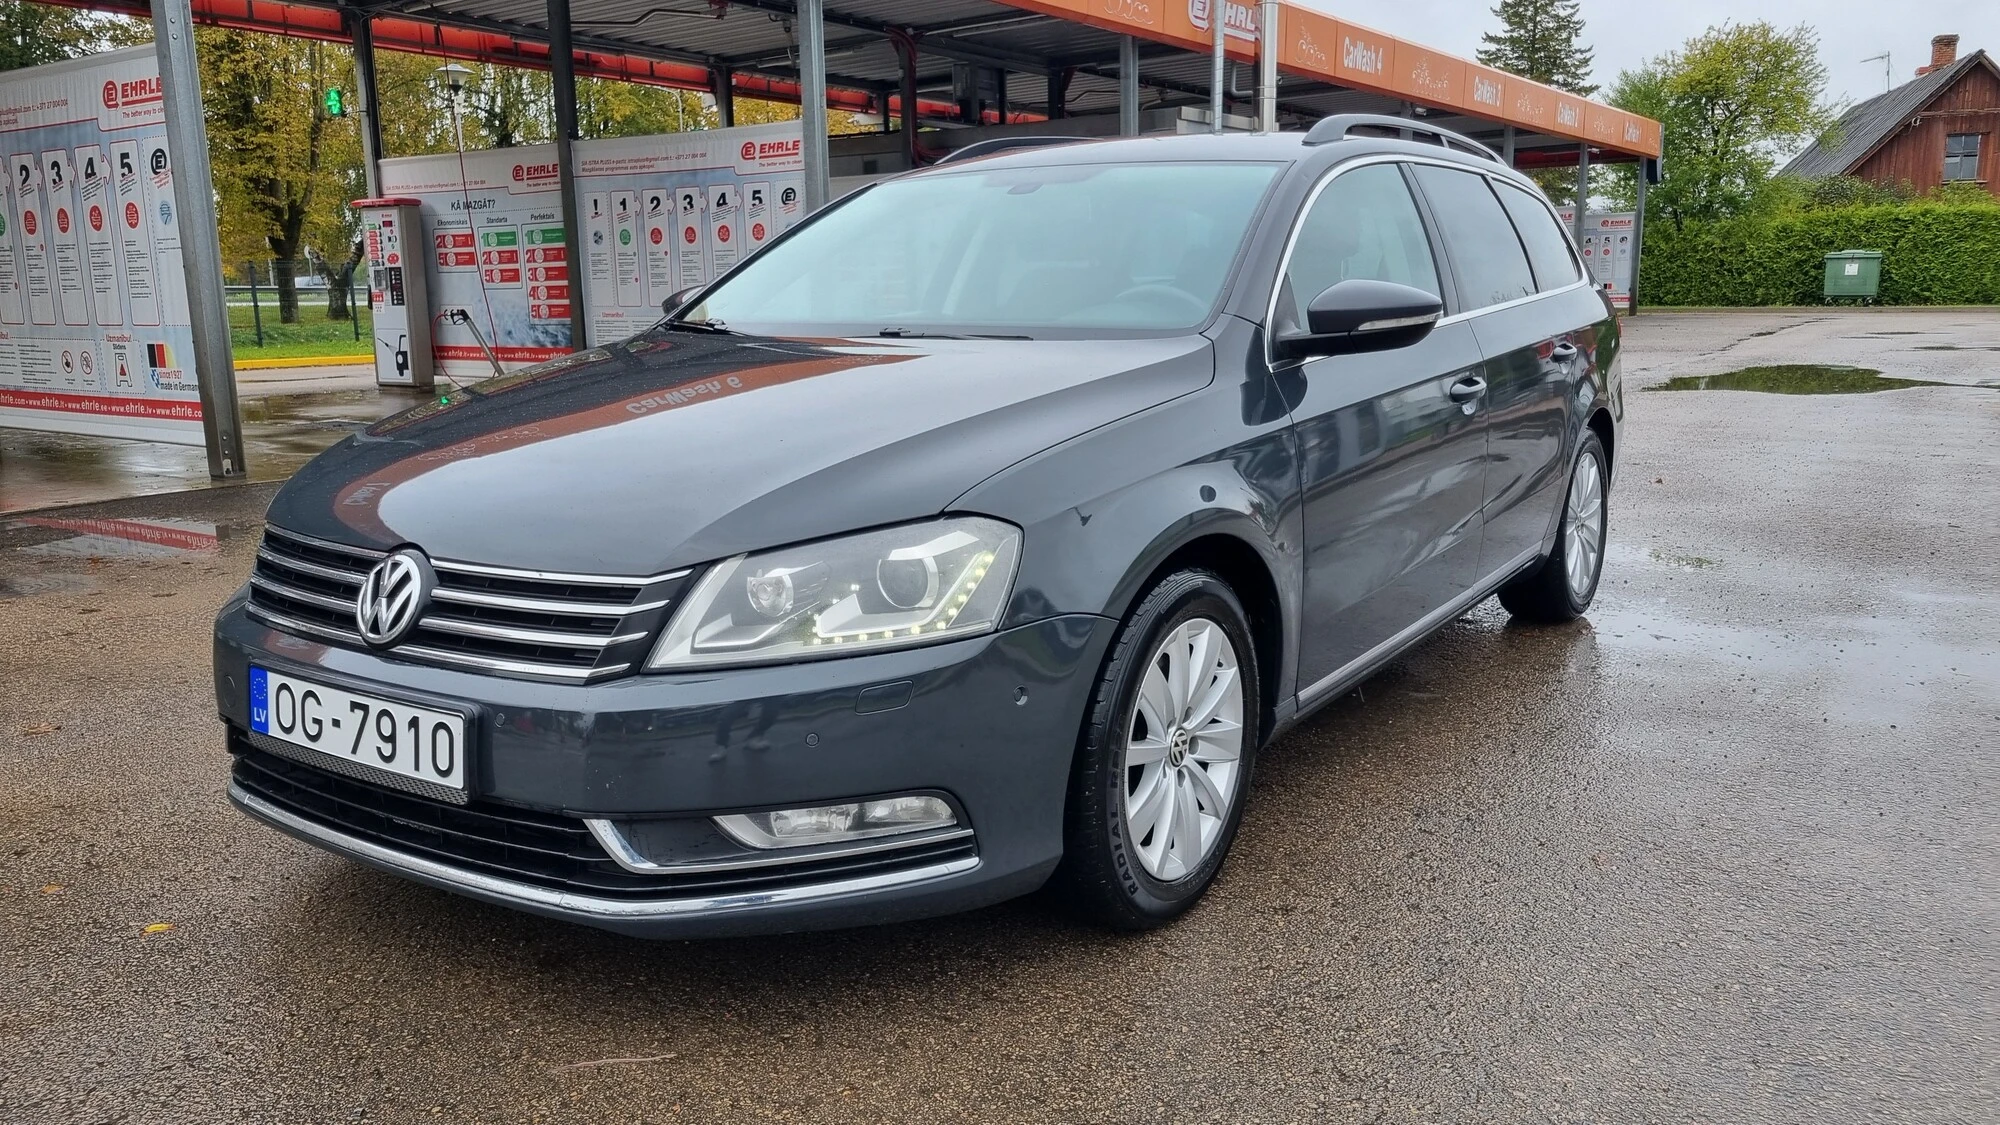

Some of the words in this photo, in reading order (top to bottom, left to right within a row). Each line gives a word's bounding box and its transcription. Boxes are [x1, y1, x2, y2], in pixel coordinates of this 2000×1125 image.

[1224, 2, 1256, 31] HRL
[1343, 36, 1375, 74] CarWash
[1376, 47, 1383, 76] 4
[1474, 75, 1496, 106] CarWash
[1557, 101, 1575, 127] CarWash
[759, 140, 800, 154] EHRLE
[50, 160, 63, 185] 3
[84, 156, 97, 180] 4
[120, 152, 133, 178] 5
[526, 163, 558, 176] EHRLE
[19, 164, 30, 187] 2
[451, 200, 460, 211] KĀ
[463, 198, 496, 210] MAZGĀT?
[620, 197, 627, 212] 1
[650, 196, 661, 212] 2
[682, 194, 694, 211] 3
[716, 192, 729, 207] 4
[752, 190, 762, 207] 5
[160, 382, 172, 390] made
[68, 398, 108, 412] www.ehrle.ee
[111, 402, 152, 414] www.ehrle.lv
[253, 708, 266, 724] LV
[275, 682, 454, 778] OG-7910
[1109, 802, 1139, 898] RADIAL
